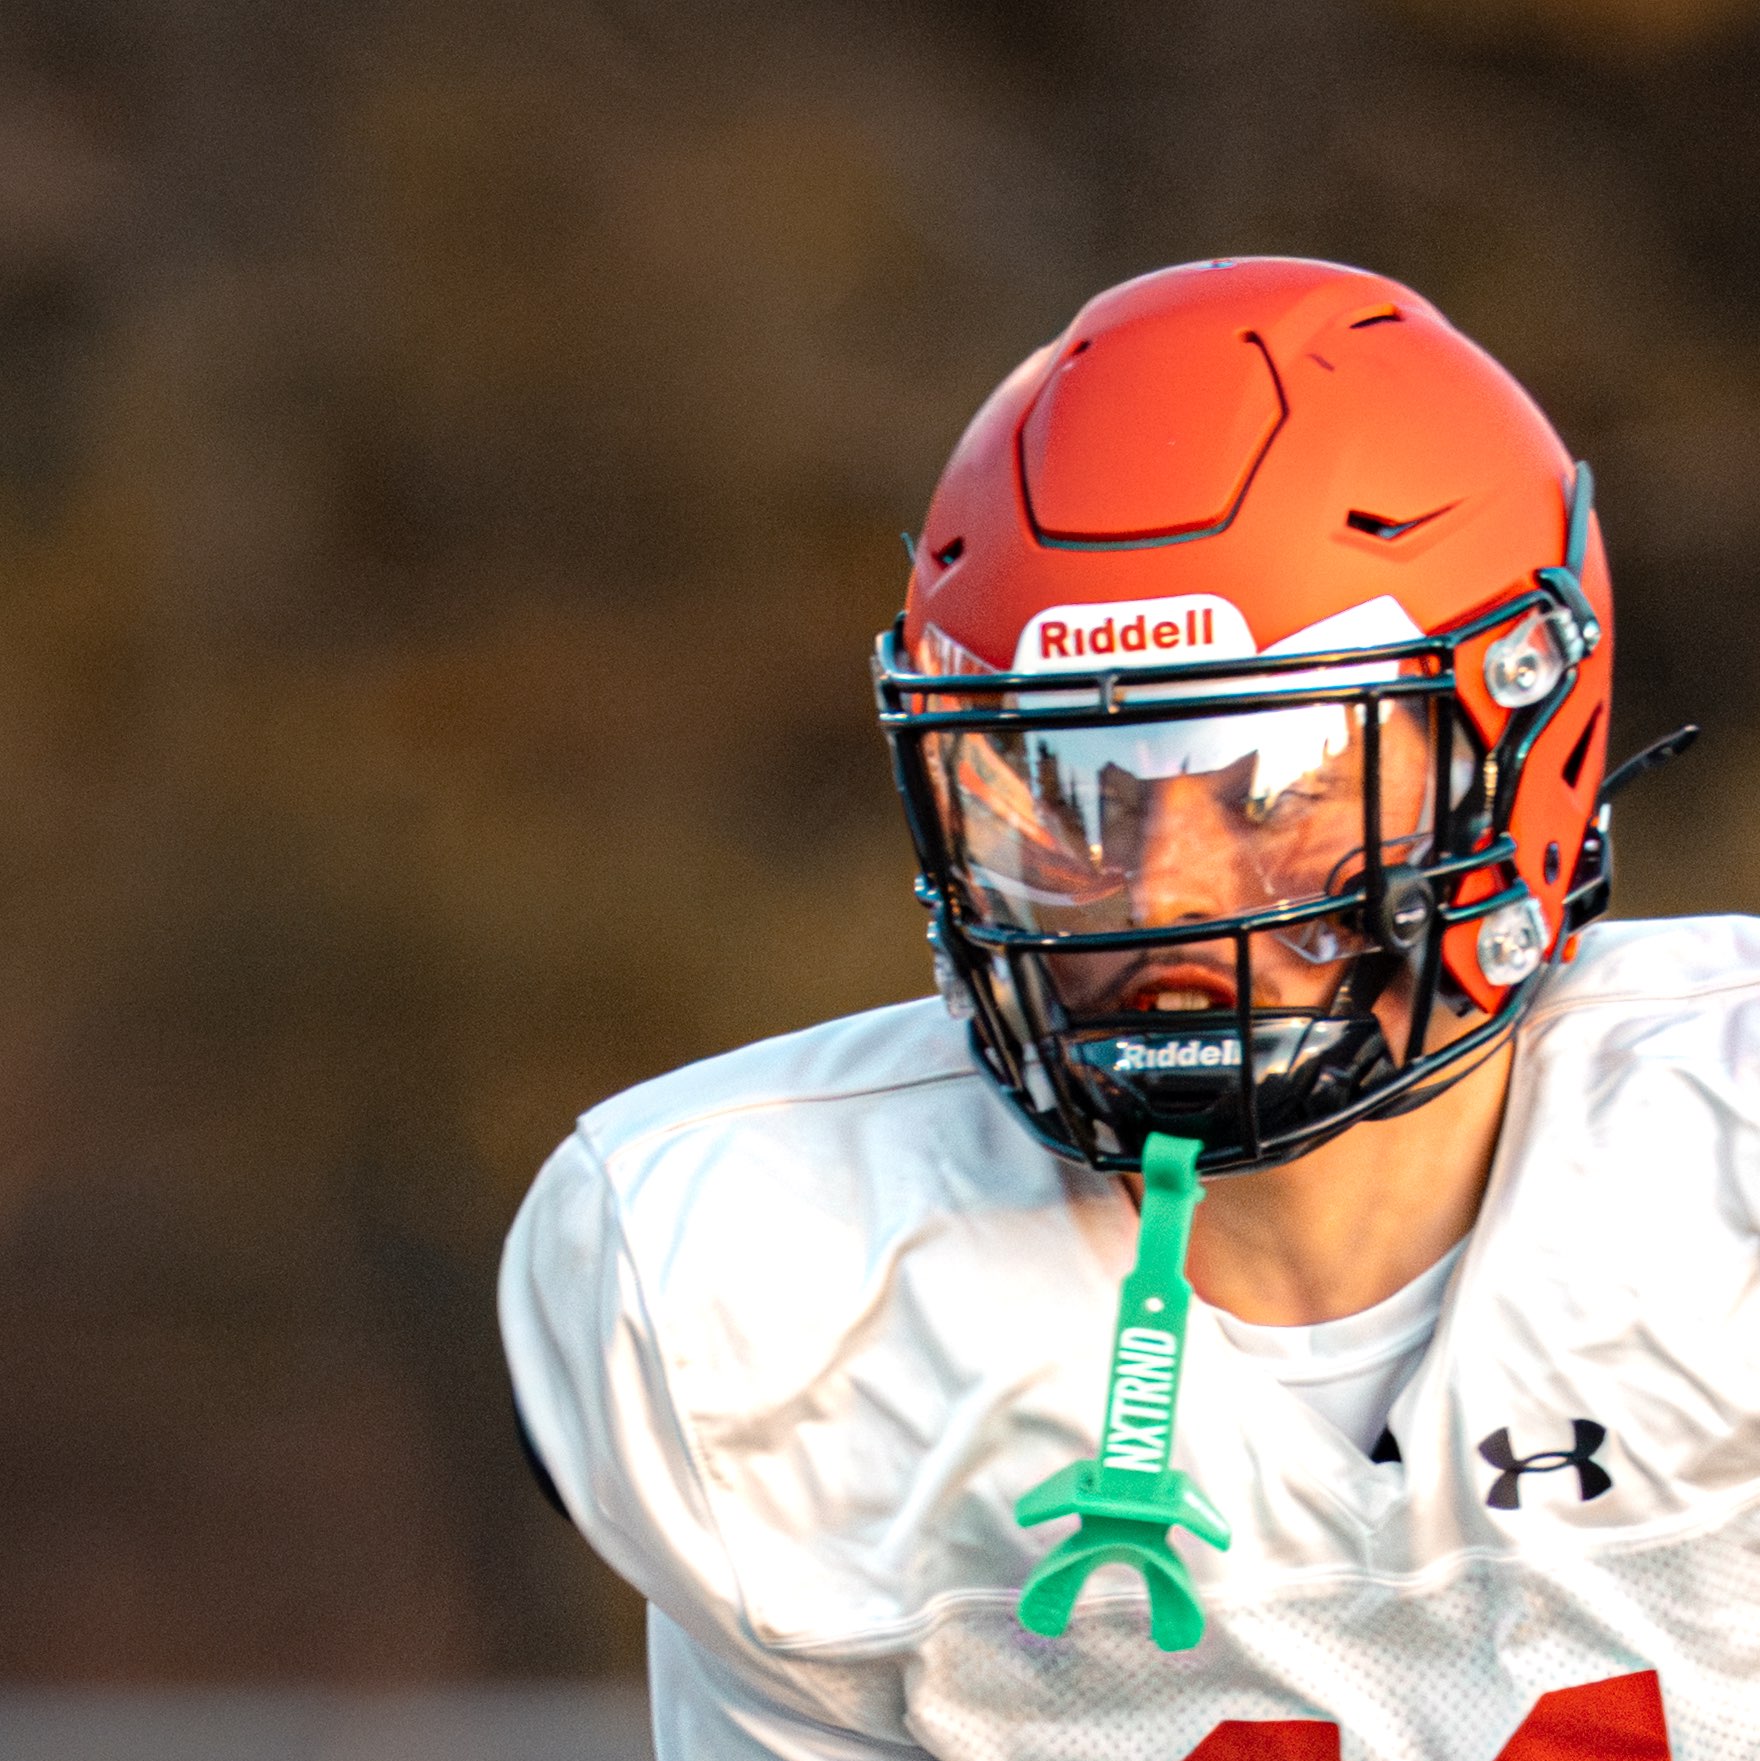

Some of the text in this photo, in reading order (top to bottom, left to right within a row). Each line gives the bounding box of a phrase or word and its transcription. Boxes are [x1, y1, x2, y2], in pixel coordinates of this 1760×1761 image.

[1040, 608, 1213, 659] Riddell
[1118, 1039, 1242, 1069] Riddell
[1103, 1327, 1177, 1474] NXTRND
